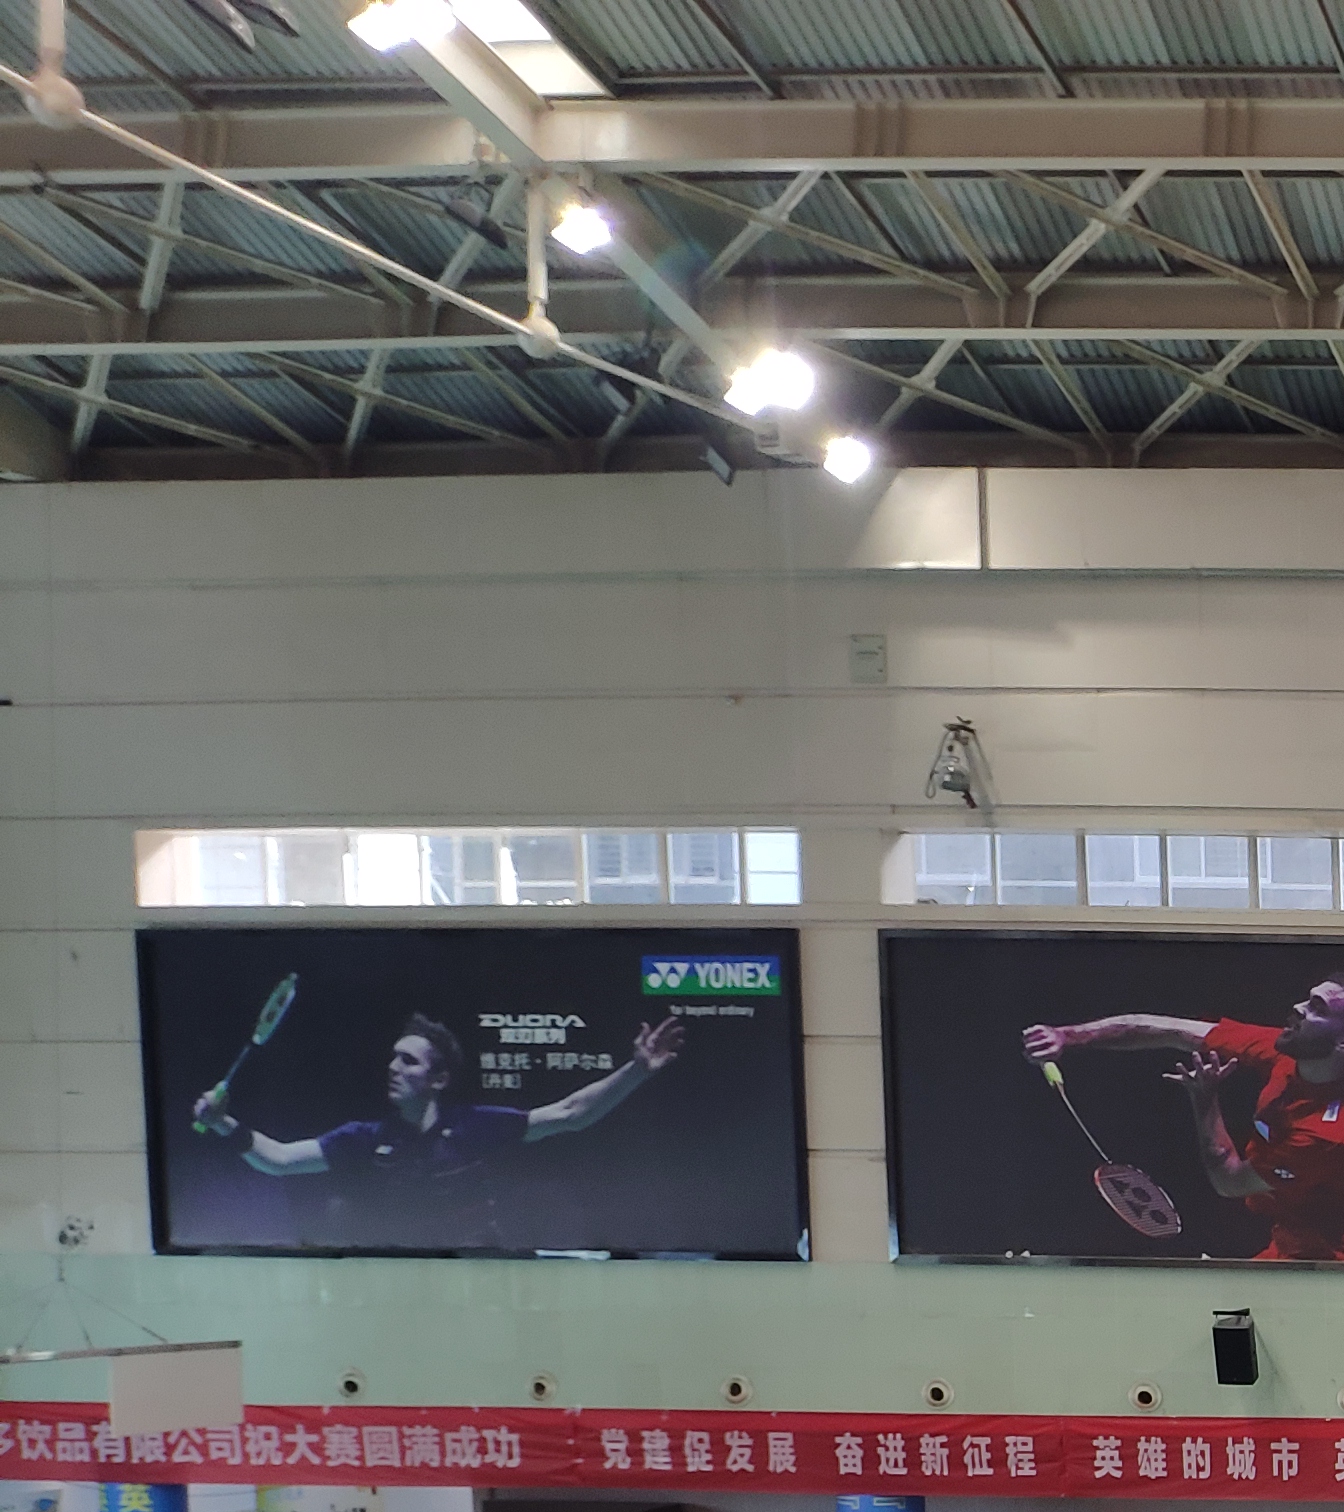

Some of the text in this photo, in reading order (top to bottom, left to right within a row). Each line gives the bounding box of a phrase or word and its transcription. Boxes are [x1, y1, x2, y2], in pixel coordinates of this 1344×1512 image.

[694, 962, 772, 988] YONEX
[478, 1014, 586, 1027] DUORA
[600, 1428, 1038, 1478] 党建促发展 奋进新征程
[1092, 1435, 1300, 1482] 英雄的城市
